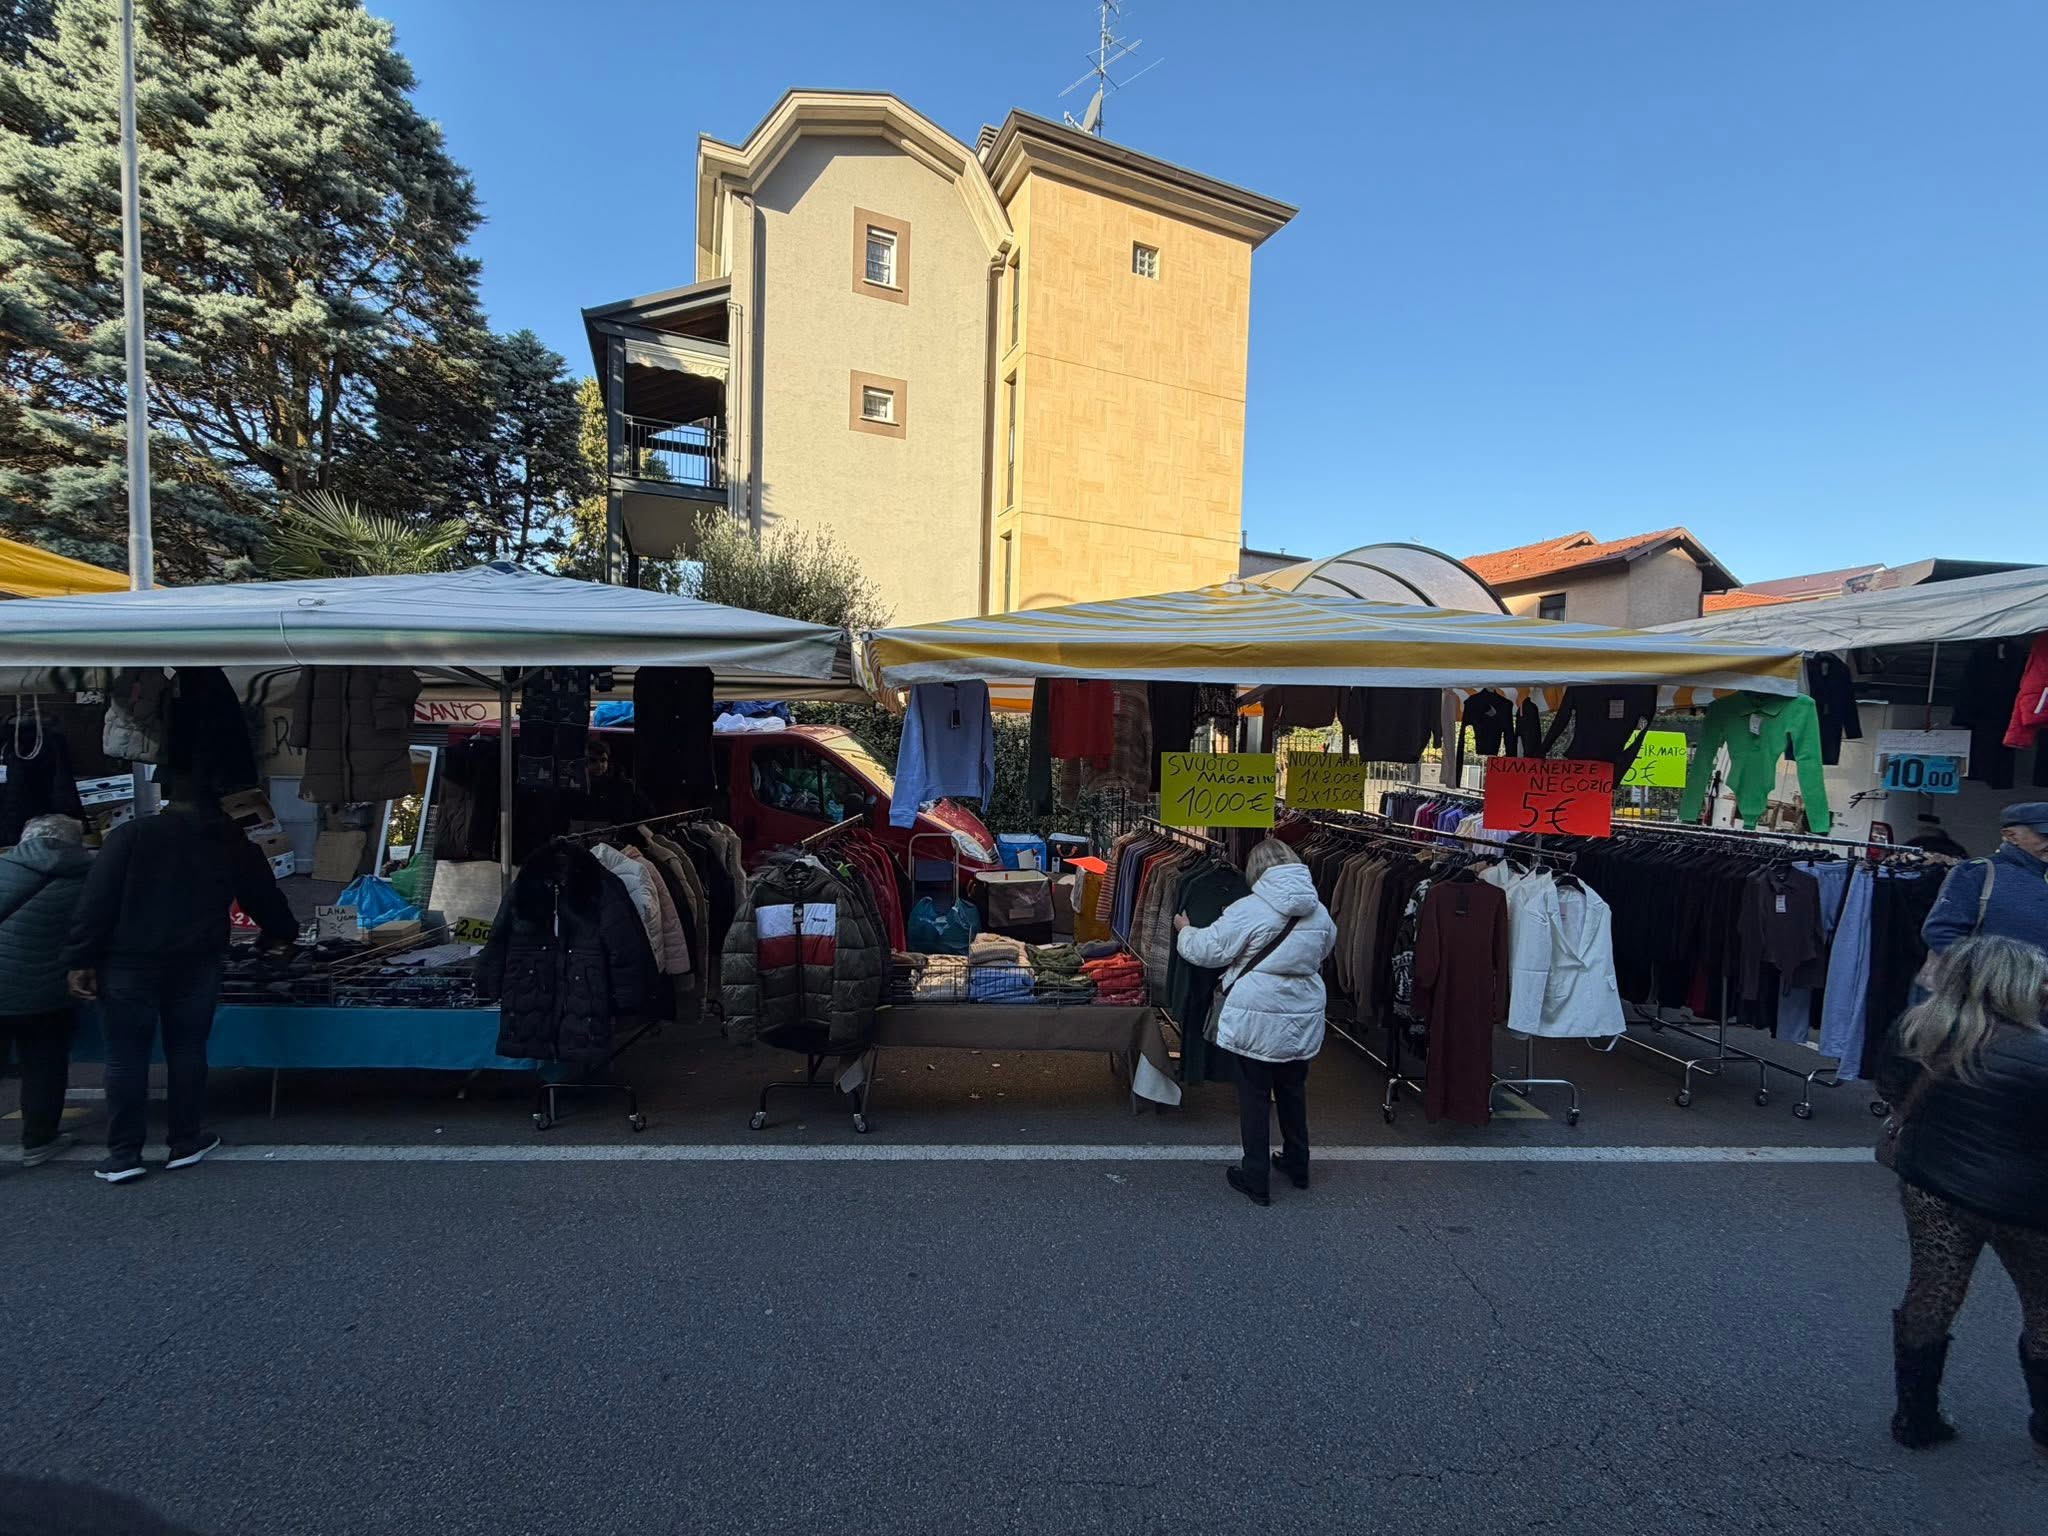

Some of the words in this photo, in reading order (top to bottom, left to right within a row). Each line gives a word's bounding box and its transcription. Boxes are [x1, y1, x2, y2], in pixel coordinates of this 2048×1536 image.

[1168, 755, 1239, 776] SVUOTO
[1490, 760, 1598, 775] RIMANENZE
[1888, 758, 1954, 788] 10.00
[1529, 777, 1613, 794] NEGOZIO
[1177, 786, 1271, 819] 10,00€
[1519, 792, 1577, 835] 5€
